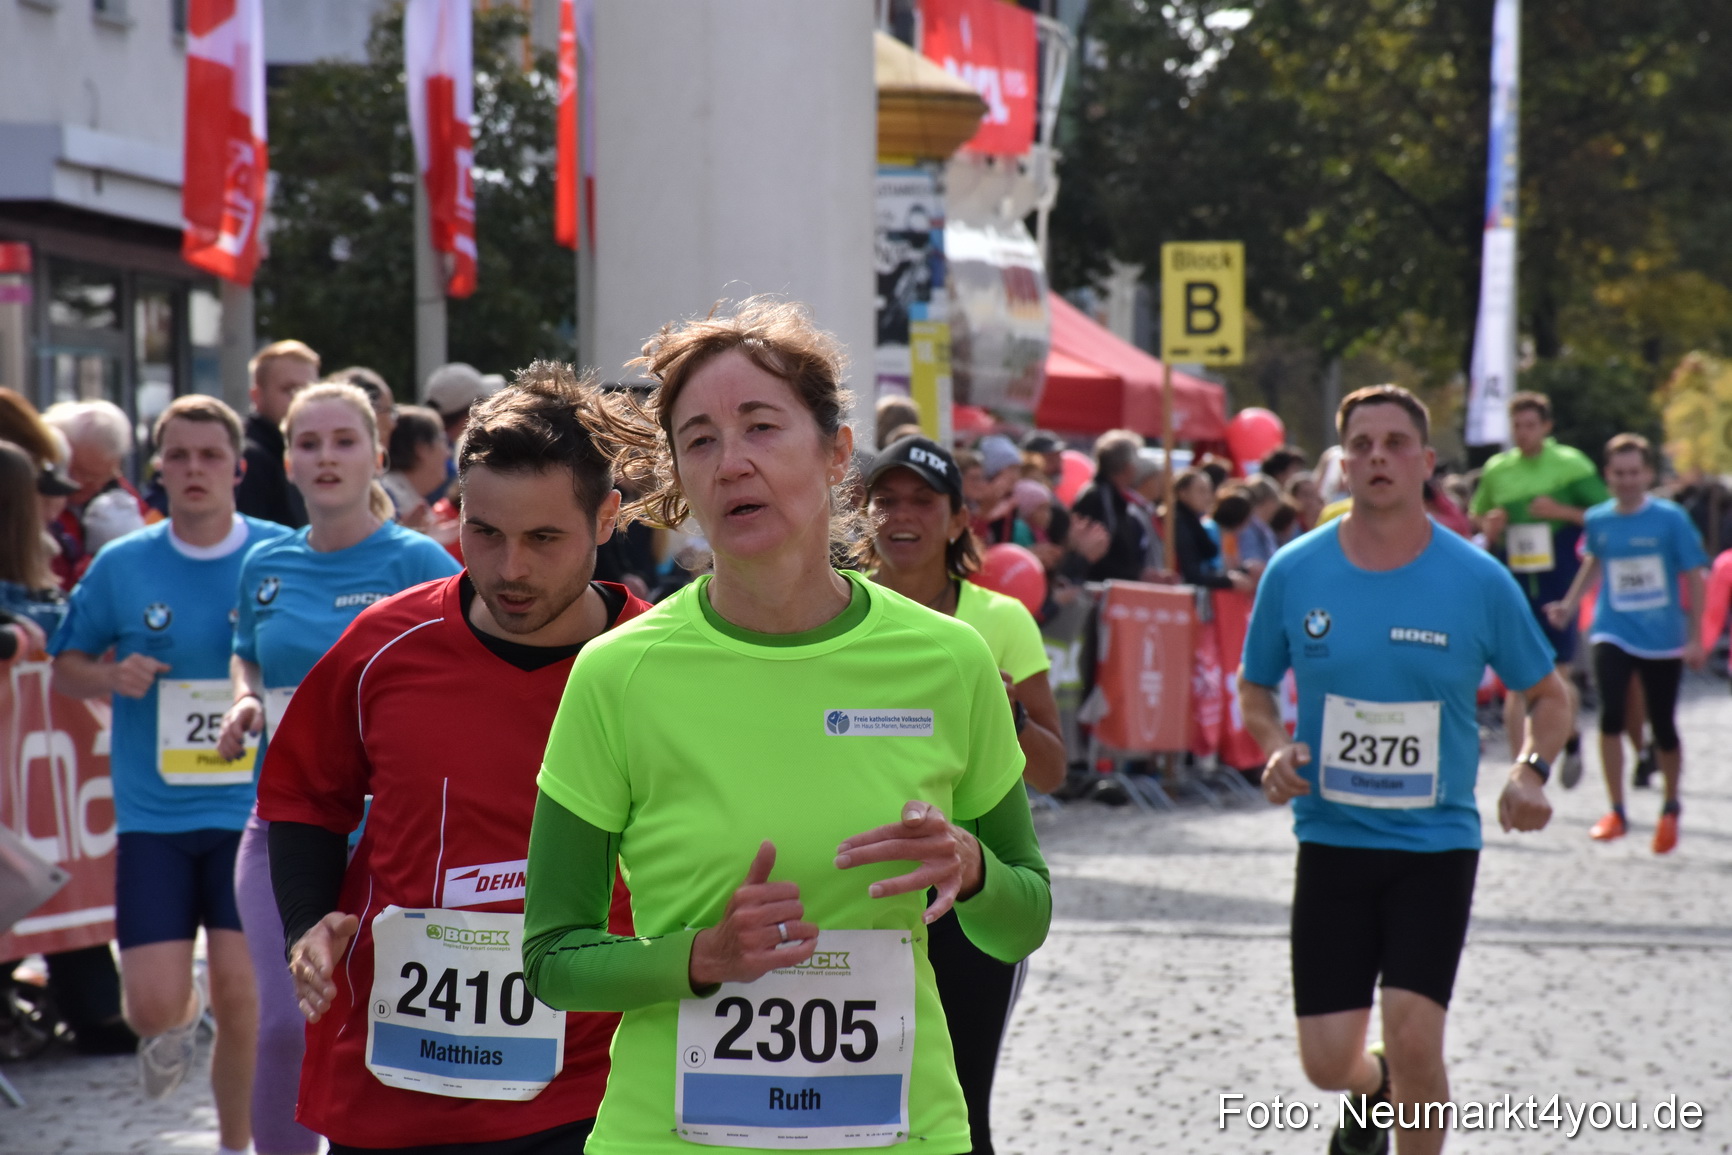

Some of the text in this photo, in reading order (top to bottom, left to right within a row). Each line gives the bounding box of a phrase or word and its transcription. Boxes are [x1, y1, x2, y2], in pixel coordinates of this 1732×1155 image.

[1185, 282, 1221, 335] B
[1390, 627, 1448, 646] BOCK
[1338, 731, 1420, 767] 2376
[1350, 775, 1404, 789] Christian
[443, 926, 510, 945] BOCK
[443, 942, 461, 950] inspired
[797, 969, 805, 977] by
[396, 961, 534, 1026] 2410
[378, 1004, 386, 1014] D
[713, 996, 879, 1064] 2305
[420, 1039, 503, 1065] Matthias
[690, 1051, 699, 1063] C
[769, 1087, 821, 1111] Ruth
